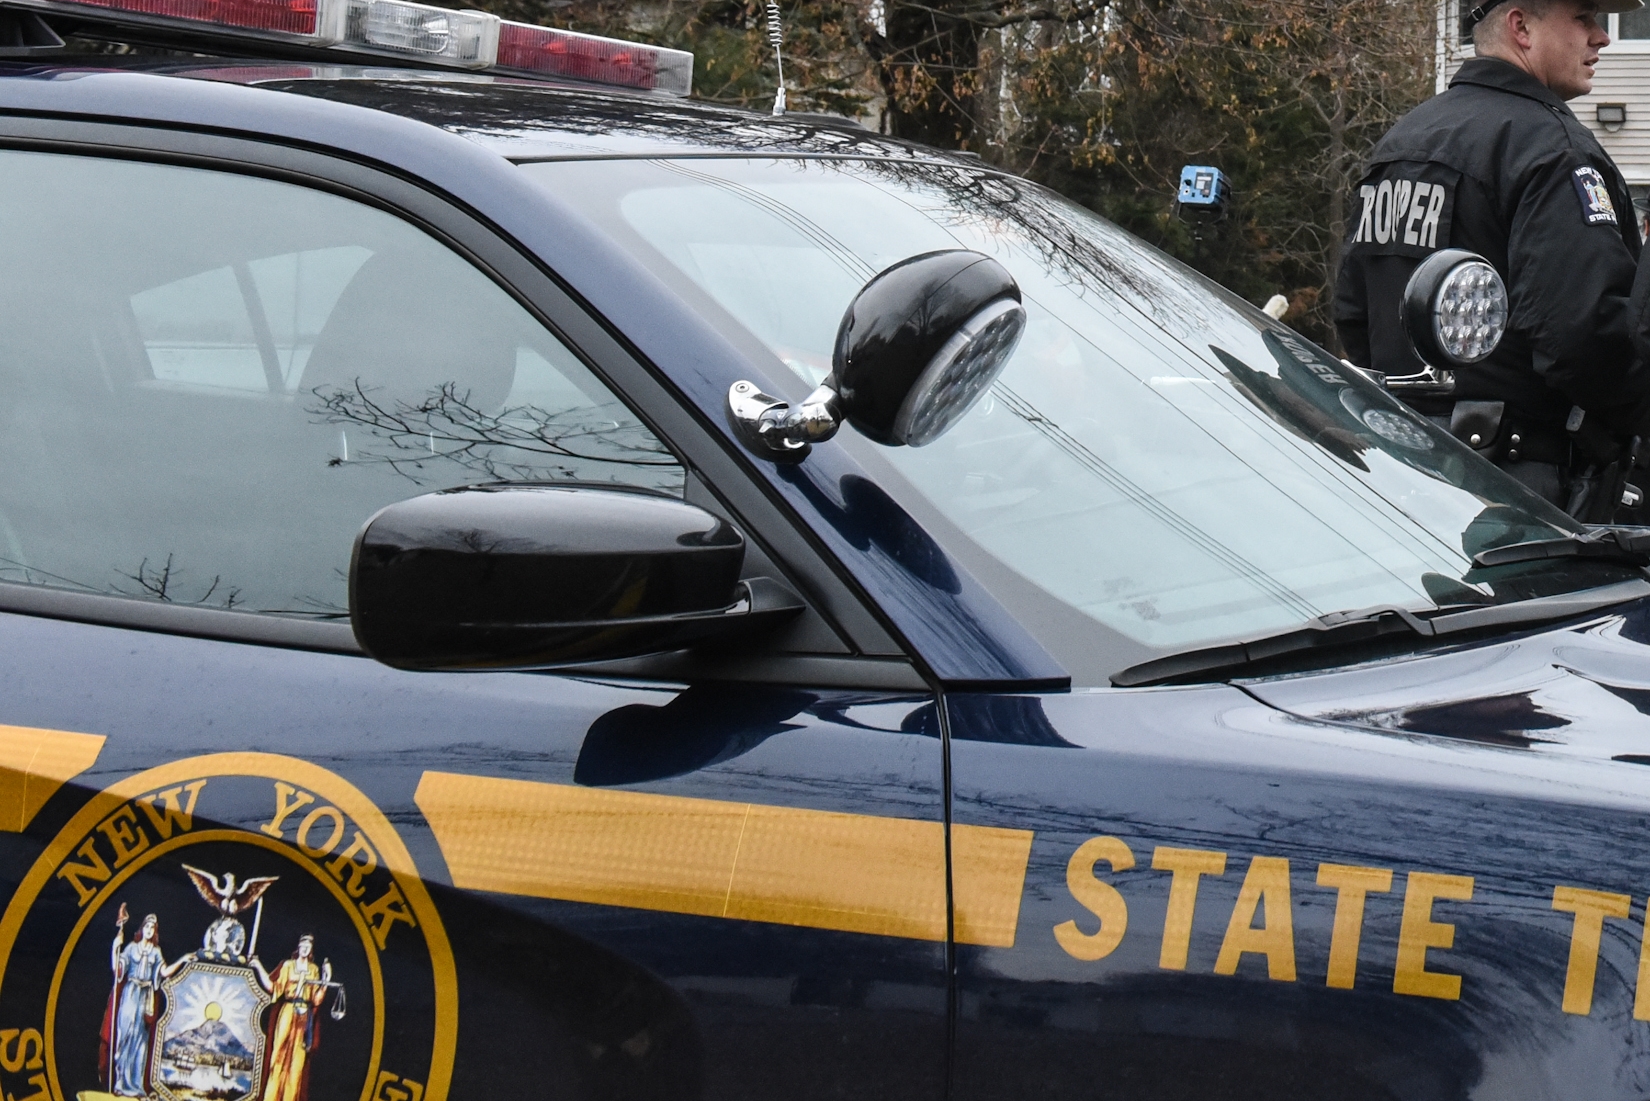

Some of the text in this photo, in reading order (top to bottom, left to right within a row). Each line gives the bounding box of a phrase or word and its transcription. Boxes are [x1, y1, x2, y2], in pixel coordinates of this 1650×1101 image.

[57, 779, 417, 950] NEW YORK
[1053, 836, 1475, 1001] STATE
